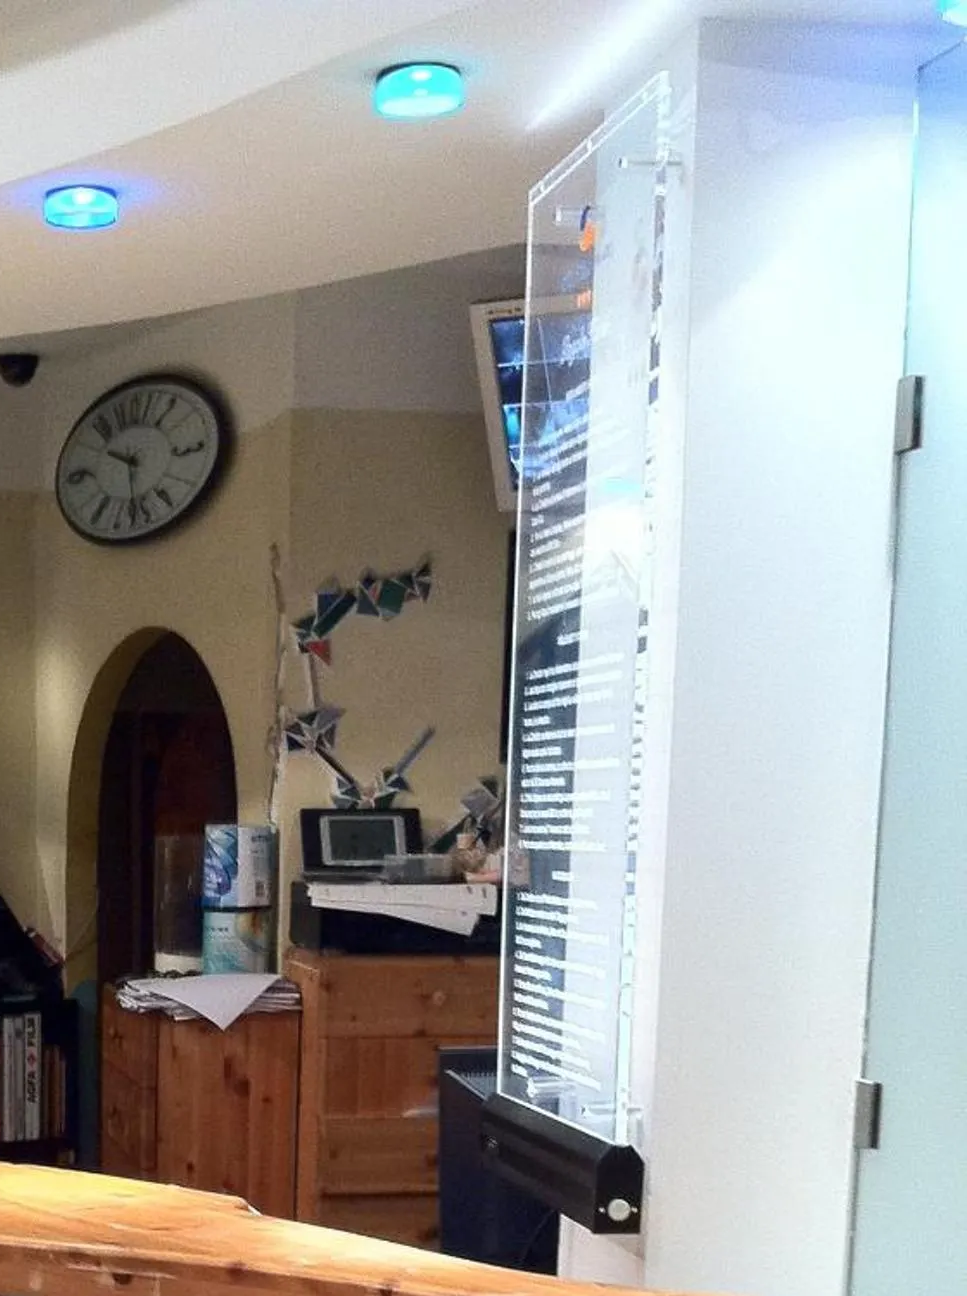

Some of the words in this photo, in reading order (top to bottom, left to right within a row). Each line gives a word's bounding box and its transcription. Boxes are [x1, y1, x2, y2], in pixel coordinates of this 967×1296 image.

[172, 440, 205, 456] 3
[67, 468, 96, 484] 9
[26, 1017, 37, 1047] FILM
[26, 1070, 38, 1104] AGFA
